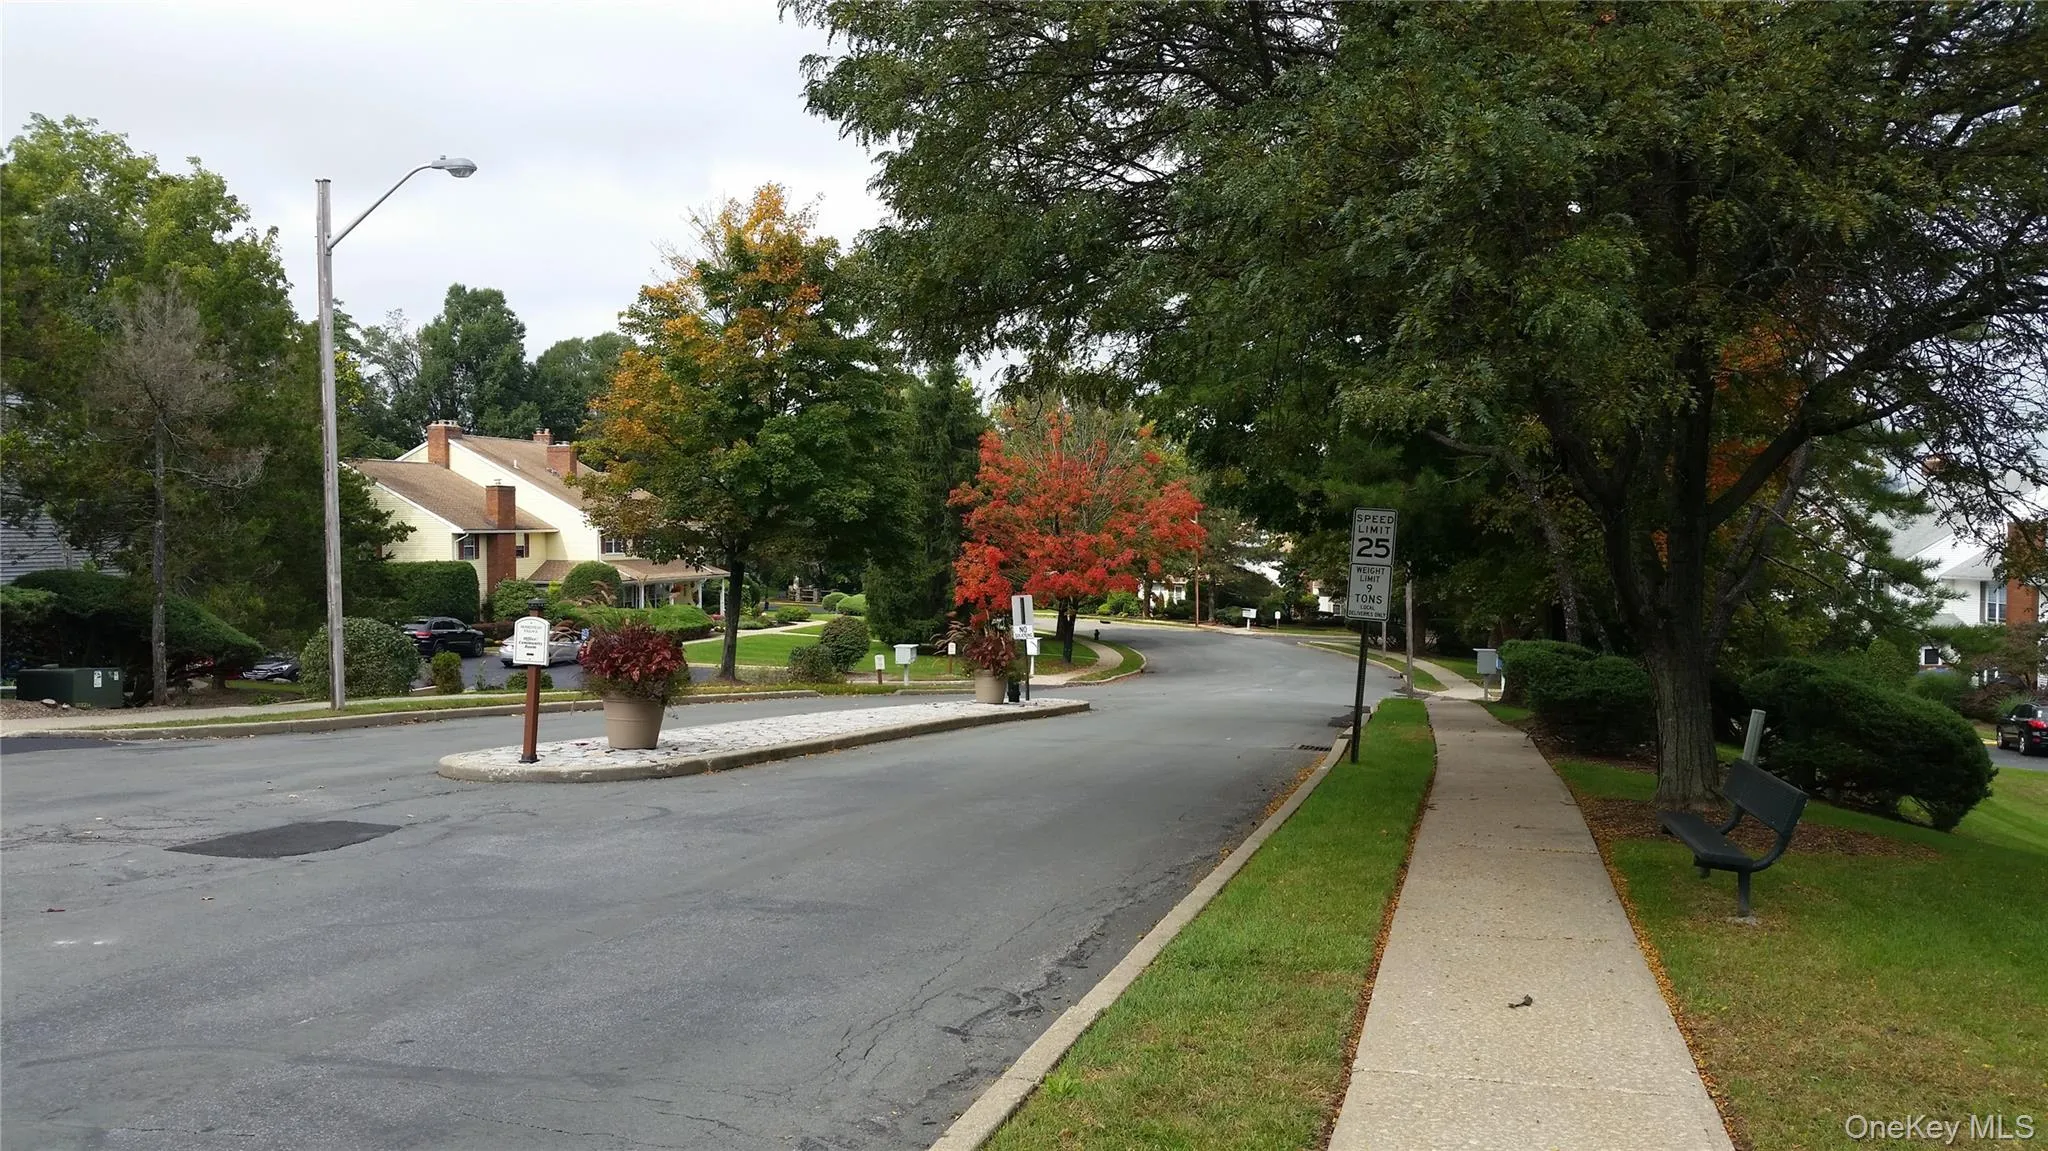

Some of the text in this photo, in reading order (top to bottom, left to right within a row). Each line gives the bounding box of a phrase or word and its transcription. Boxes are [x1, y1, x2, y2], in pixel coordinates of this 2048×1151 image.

[1357, 514, 1394, 524] SPEED
[1358, 525, 1391, 535] LIMIT
[1356, 537, 1391, 559] 25
[1356, 566, 1386, 575] WEIGHT
[1359, 574, 1380, 583] LIMIT
[1366, 583, 1373, 593] 9
[1355, 593, 1383, 605] TONS
